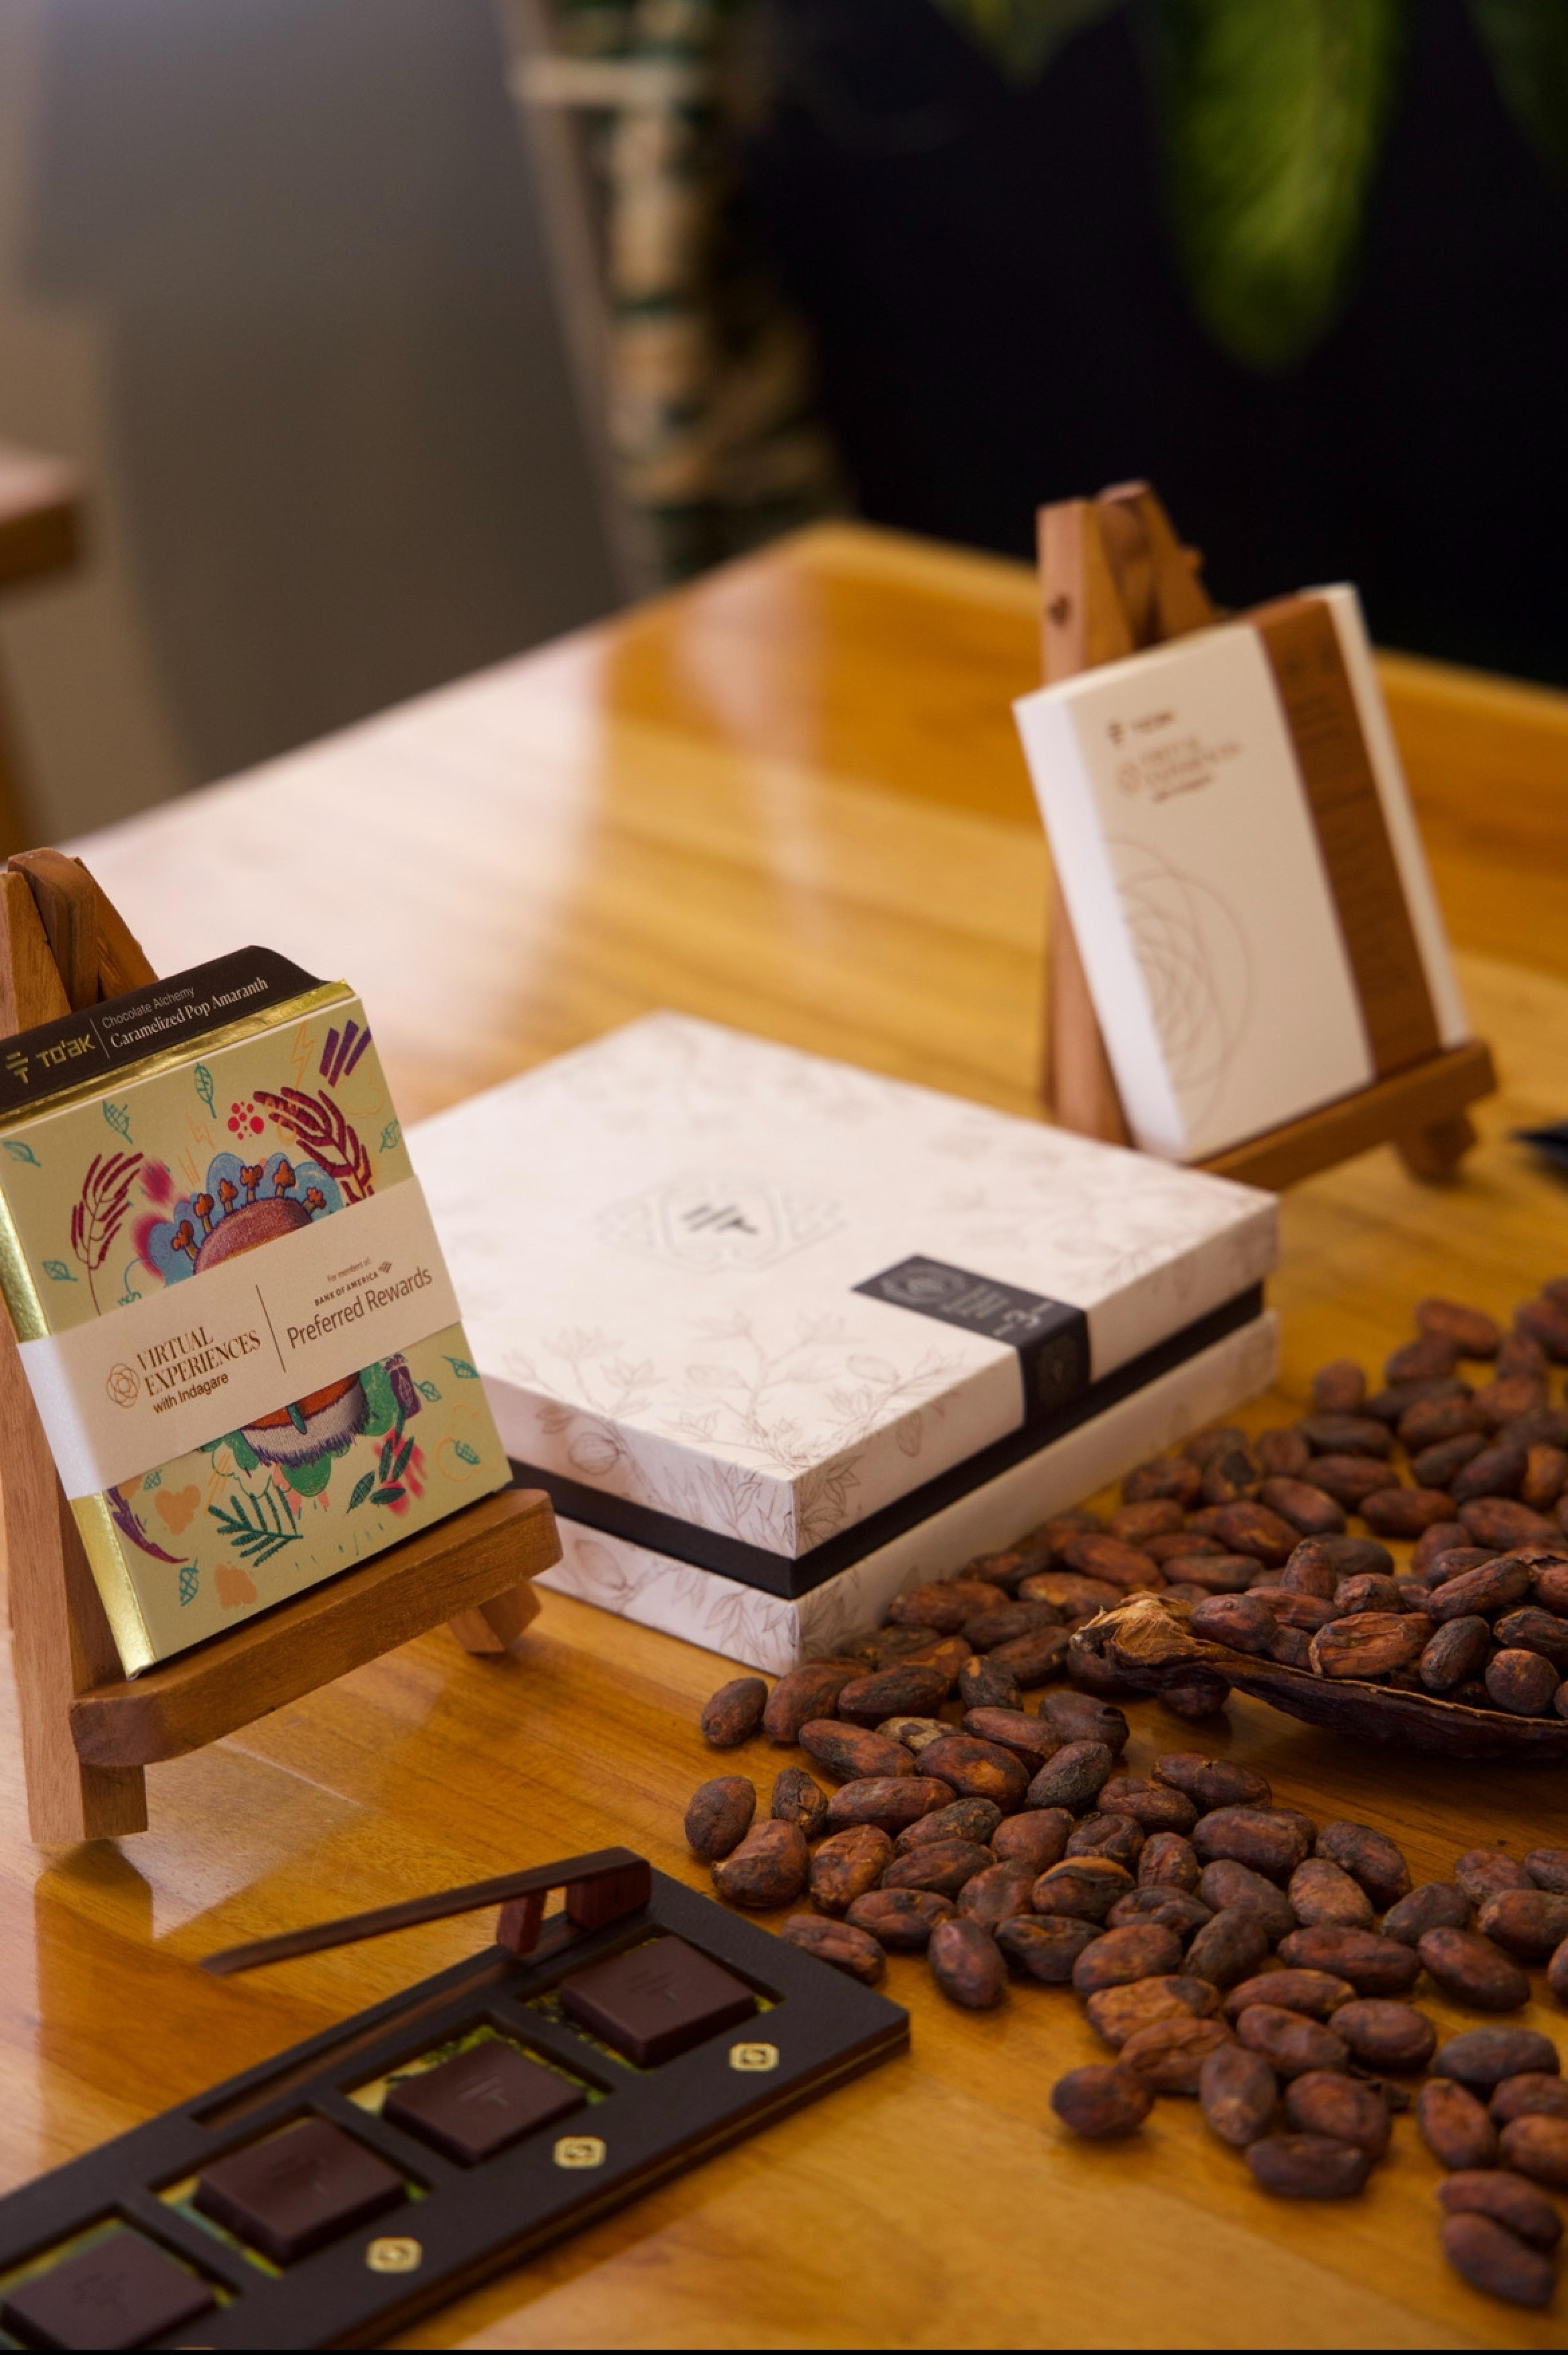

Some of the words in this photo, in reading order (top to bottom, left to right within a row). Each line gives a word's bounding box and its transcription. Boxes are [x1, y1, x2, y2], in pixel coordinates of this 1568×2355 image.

[101, 1002, 152, 1029] Chocolate
[153, 986, 195, 1009] Alchemy
[110, 1007, 186, 1048] Caramelized
[185, 1001, 211, 1019] Pop
[211, 977, 269, 1010] Amaranth
[287, 1294, 365, 1349] Preferred
[365, 1266, 432, 1312] Rewards
[313, 1291, 335, 1306] BANK
[336, 1287, 345, 1296] OF
[346, 1271, 379, 1291] AMERICA
[136, 1327, 214, 1370] VIRTUAL
[145, 1329, 261, 1397] EXPERIENCES
[153, 1395, 178, 1414] with
[177, 1373, 229, 1403] Indagare
